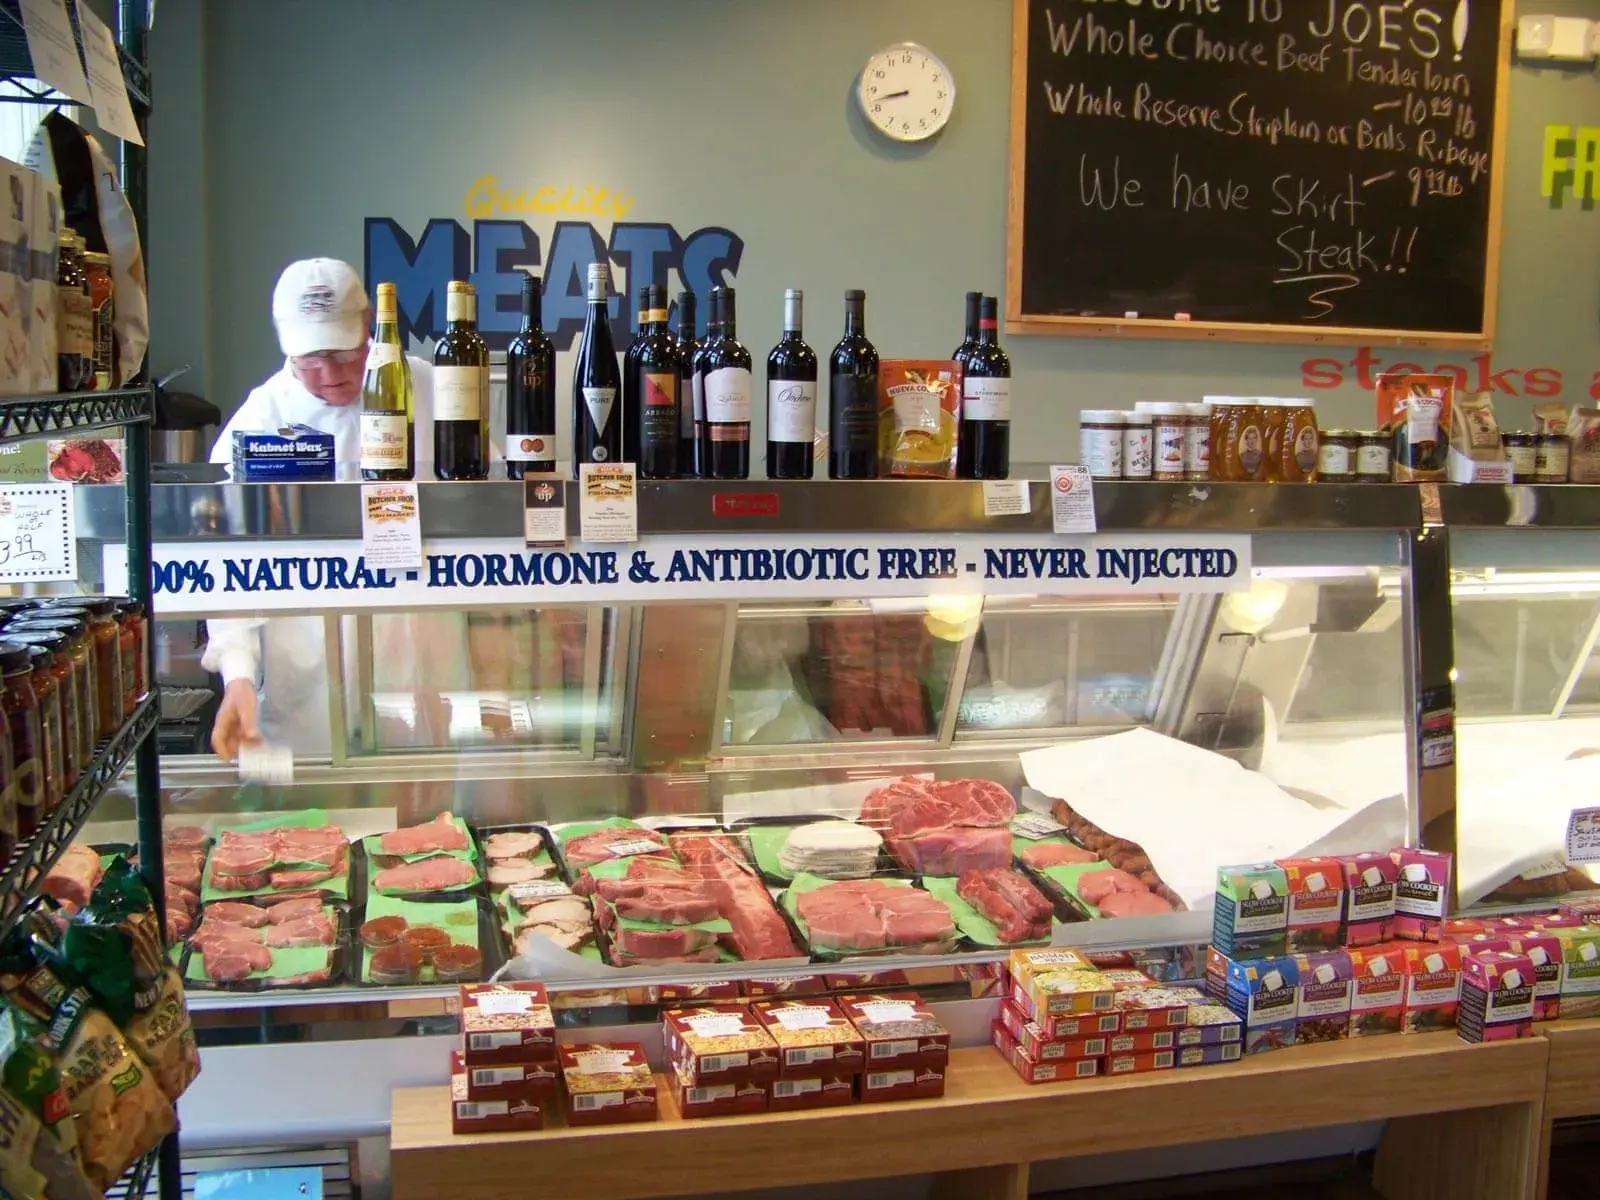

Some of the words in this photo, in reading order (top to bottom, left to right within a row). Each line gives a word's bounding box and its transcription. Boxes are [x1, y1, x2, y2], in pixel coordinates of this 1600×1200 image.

[1046, 8, 1159, 59] Whole
[1167, 22, 1268, 66] Choice
[1277, 33, 1332, 73] Beef
[1043, 80, 1126, 118] Whole
[1134, 82, 1224, 132] Reserve
[1327, 128, 1350, 145] or
[1418, 129, 1488, 184] Ribeye
[464, 175, 637, 221] Quality
[1080, 153, 1144, 210] We
[1171, 154, 1250, 210] have
[1272, 174, 1366, 226] Skirt
[365, 216, 744, 354] MEATS
[889, 385, 914, 396] NUEVA
[296, 442, 322, 452] Wax
[152, 559, 214, 594] 00%
[223, 555, 396, 592] NATURAL
[426, 552, 619, 587] HORMONE
[628, 550, 659, 583] &
[665, 548, 868, 582] ANTIBIOTIC
[877, 548, 958, 580] FREE
[984, 548, 1090, 579] NEVER
[1096, 548, 1237, 585] INJECTED
